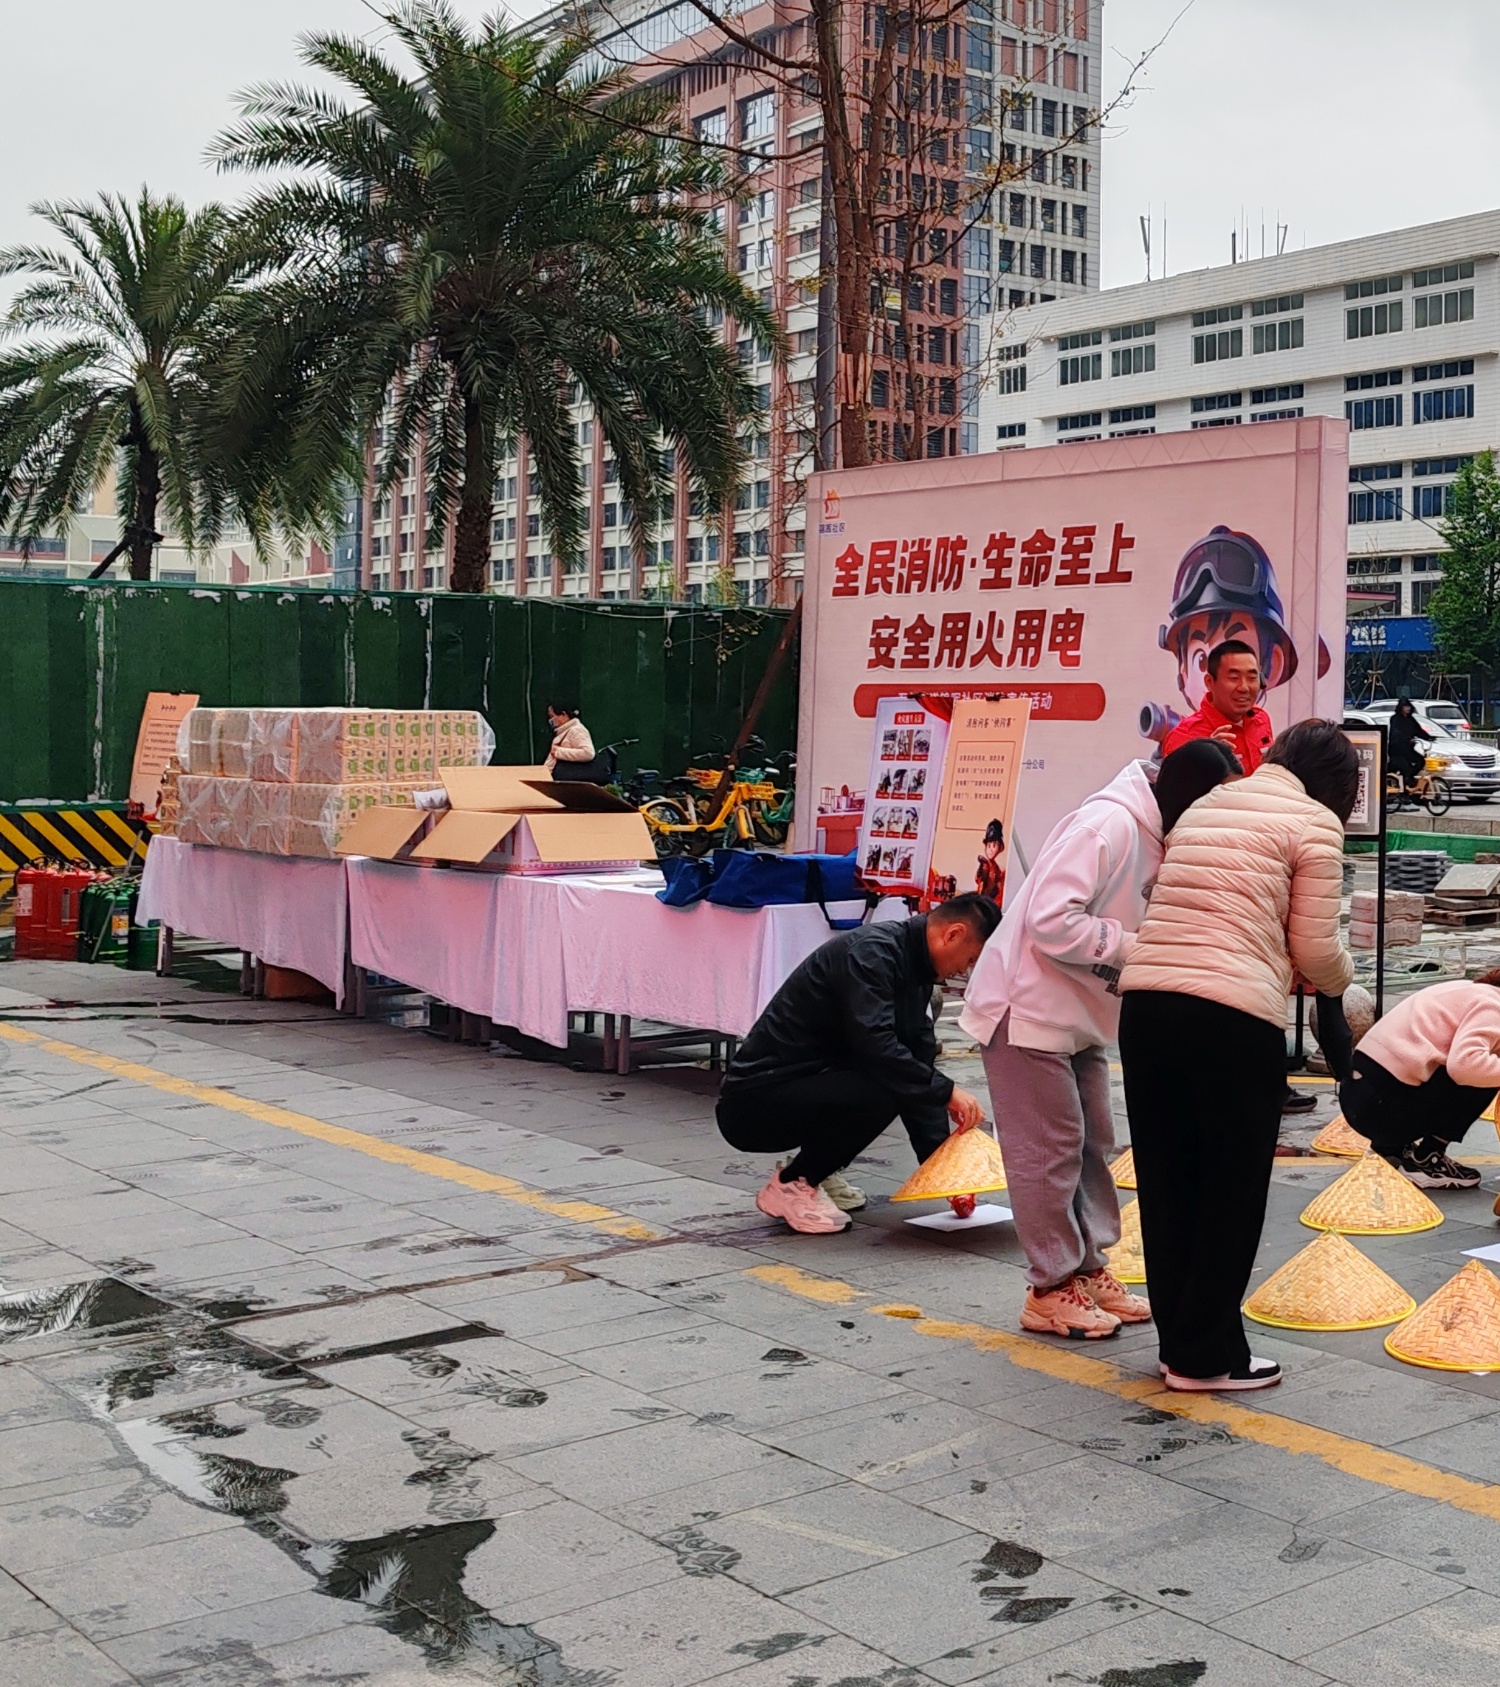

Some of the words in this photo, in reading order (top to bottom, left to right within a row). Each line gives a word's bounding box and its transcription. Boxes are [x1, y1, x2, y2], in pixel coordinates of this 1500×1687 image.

[831, 522, 1136, 598] 全民消防·生命至上
[866, 607, 1086, 670] 安全用火用电
